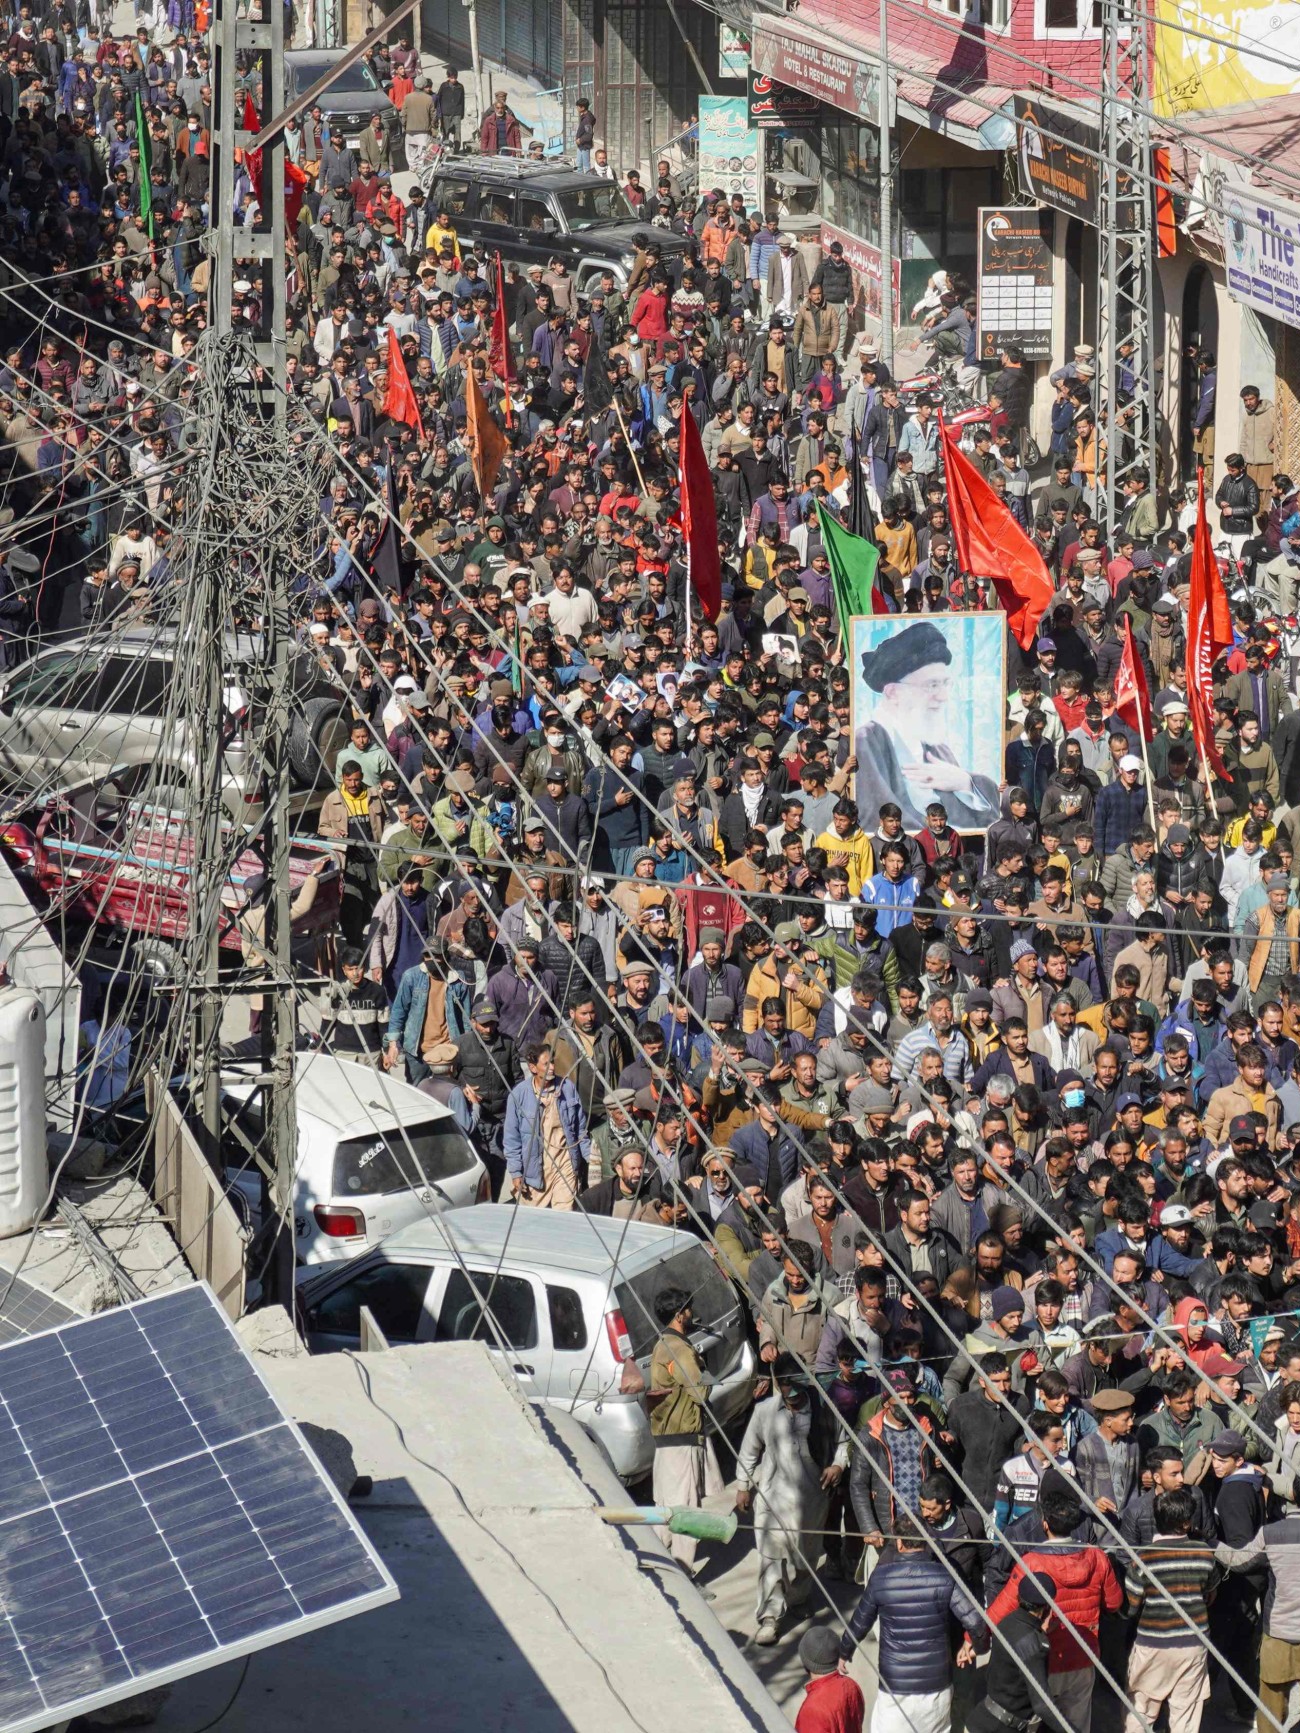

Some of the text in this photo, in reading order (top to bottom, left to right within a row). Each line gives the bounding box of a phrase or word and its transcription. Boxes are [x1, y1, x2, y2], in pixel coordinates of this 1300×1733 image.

[783, 56, 803, 76] HOTEL
[808, 67, 847, 94] RESTAURANT
[795, 41, 821, 65] MAHAL
[822, 51, 852, 78] SKARDU
[1029, 159, 1051, 184] KARACHI
[1257, 207, 1294, 267] The
[1259, 259, 1299, 290] Handicrafts
